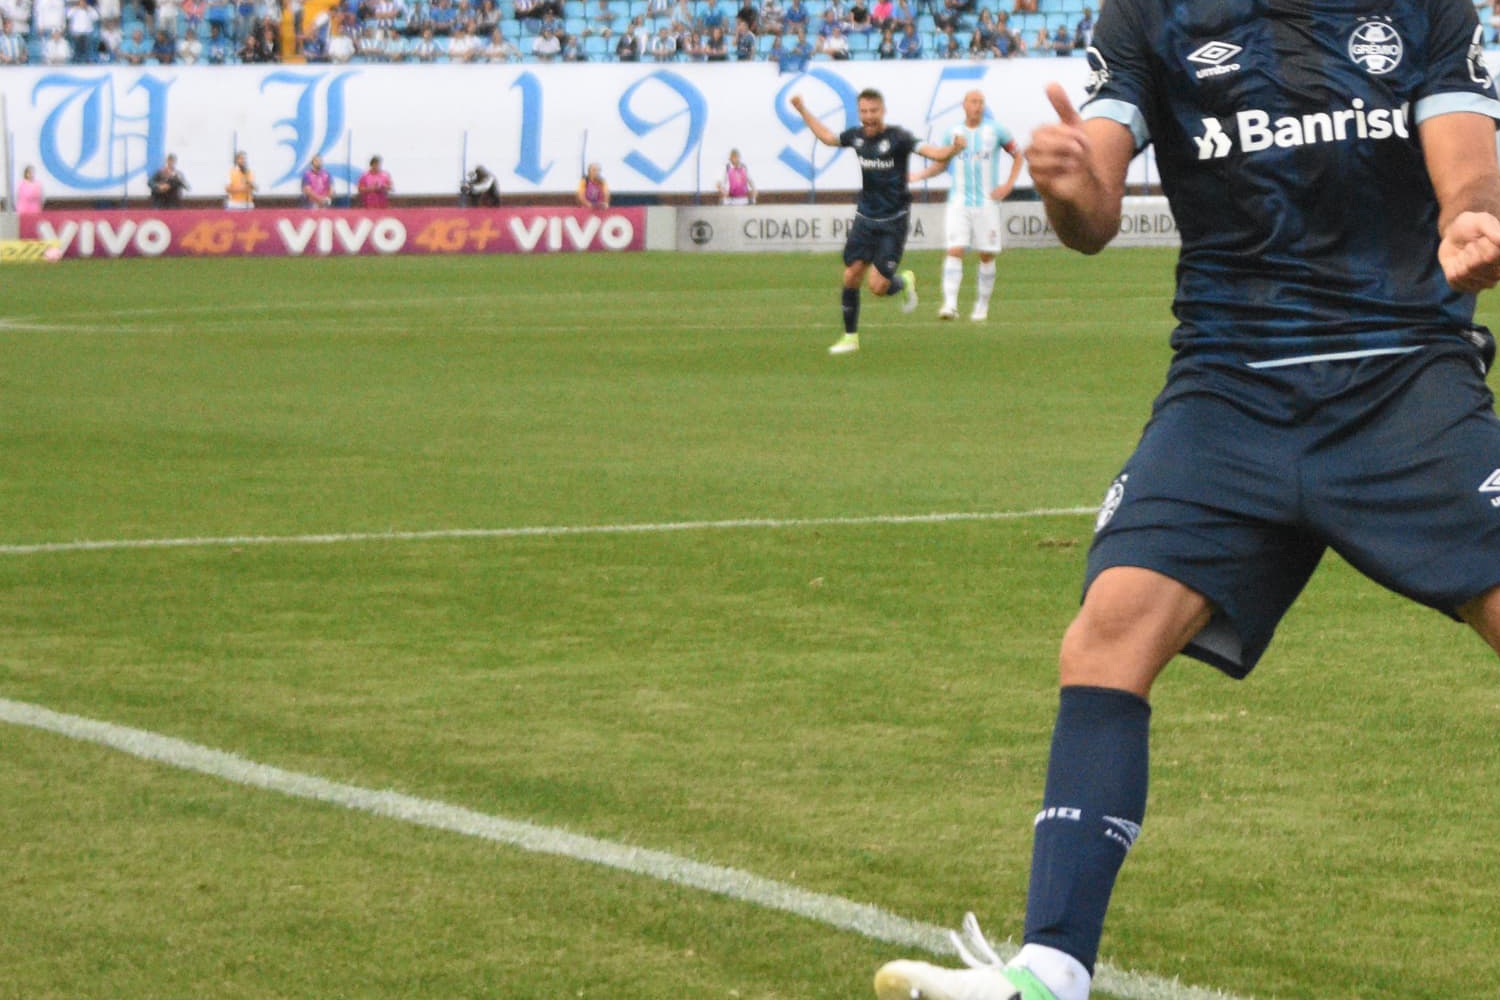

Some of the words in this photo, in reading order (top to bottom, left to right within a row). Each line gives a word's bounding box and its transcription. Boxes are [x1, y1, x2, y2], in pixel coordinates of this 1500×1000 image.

[1196, 61, 1241, 79] umbro
[38, 219, 171, 256] VIVO
[277, 217, 407, 255] VIVO
[509, 214, 634, 251] VIVO
[743, 216, 821, 240] CIDADE
